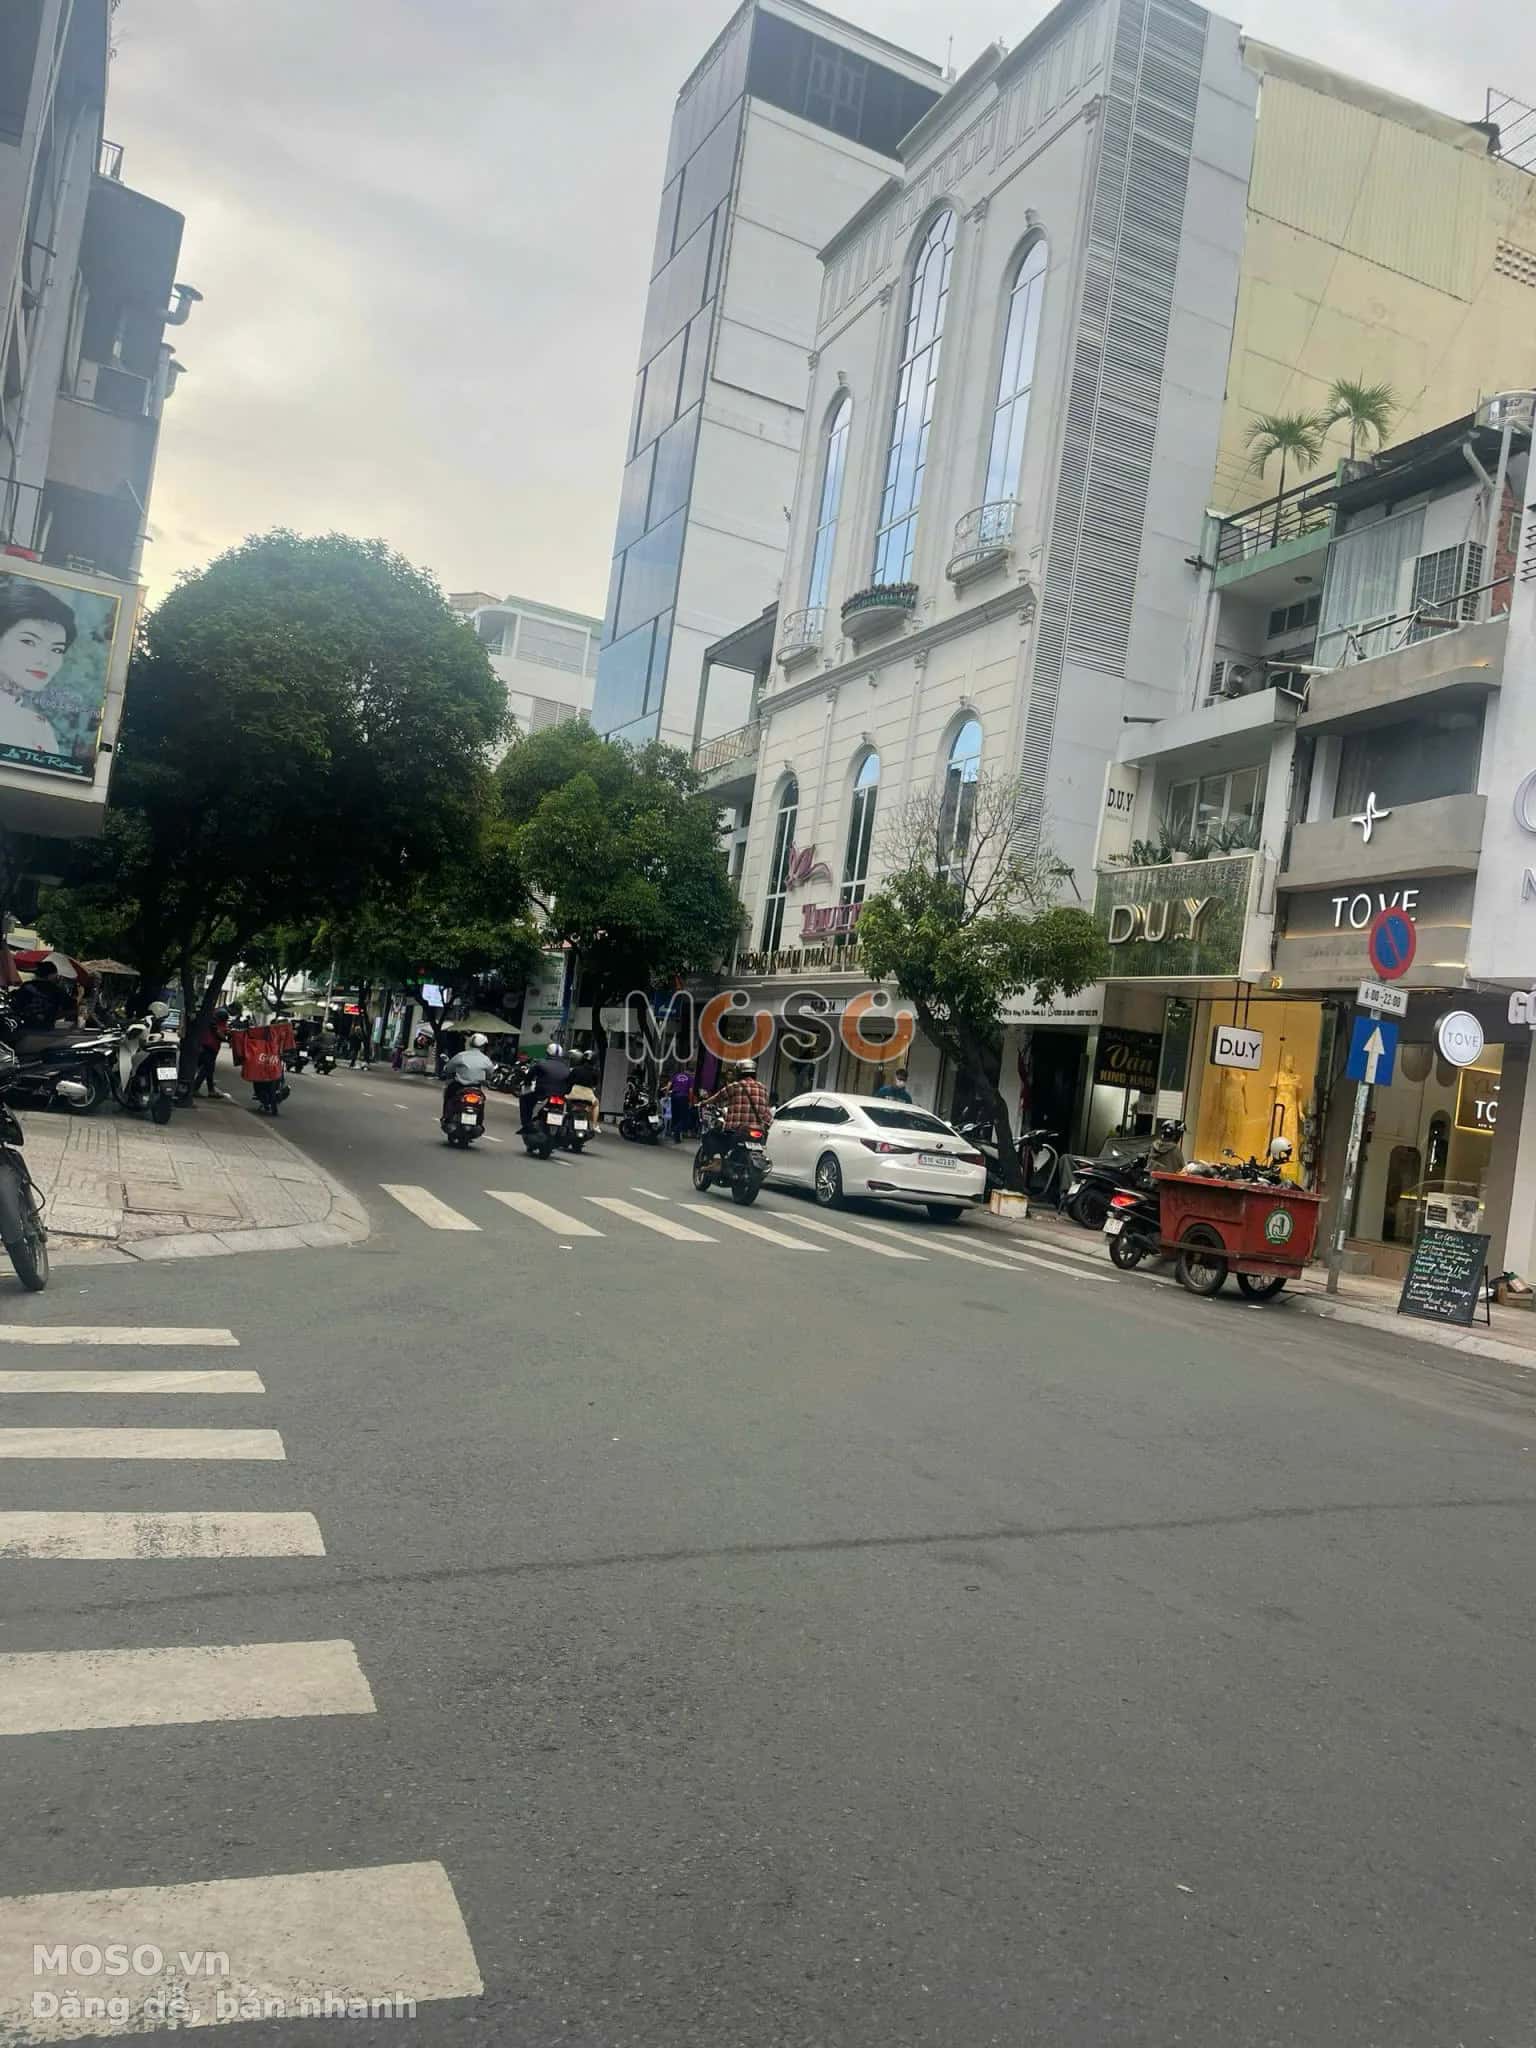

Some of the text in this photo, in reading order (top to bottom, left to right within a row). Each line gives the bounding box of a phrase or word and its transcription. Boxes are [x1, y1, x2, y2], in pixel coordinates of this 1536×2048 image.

[1108, 788, 1133, 812] D.U.Y
[1219, 1038, 1260, 1060] D.U.Y
[1448, 1032, 1479, 1049] TOVE
